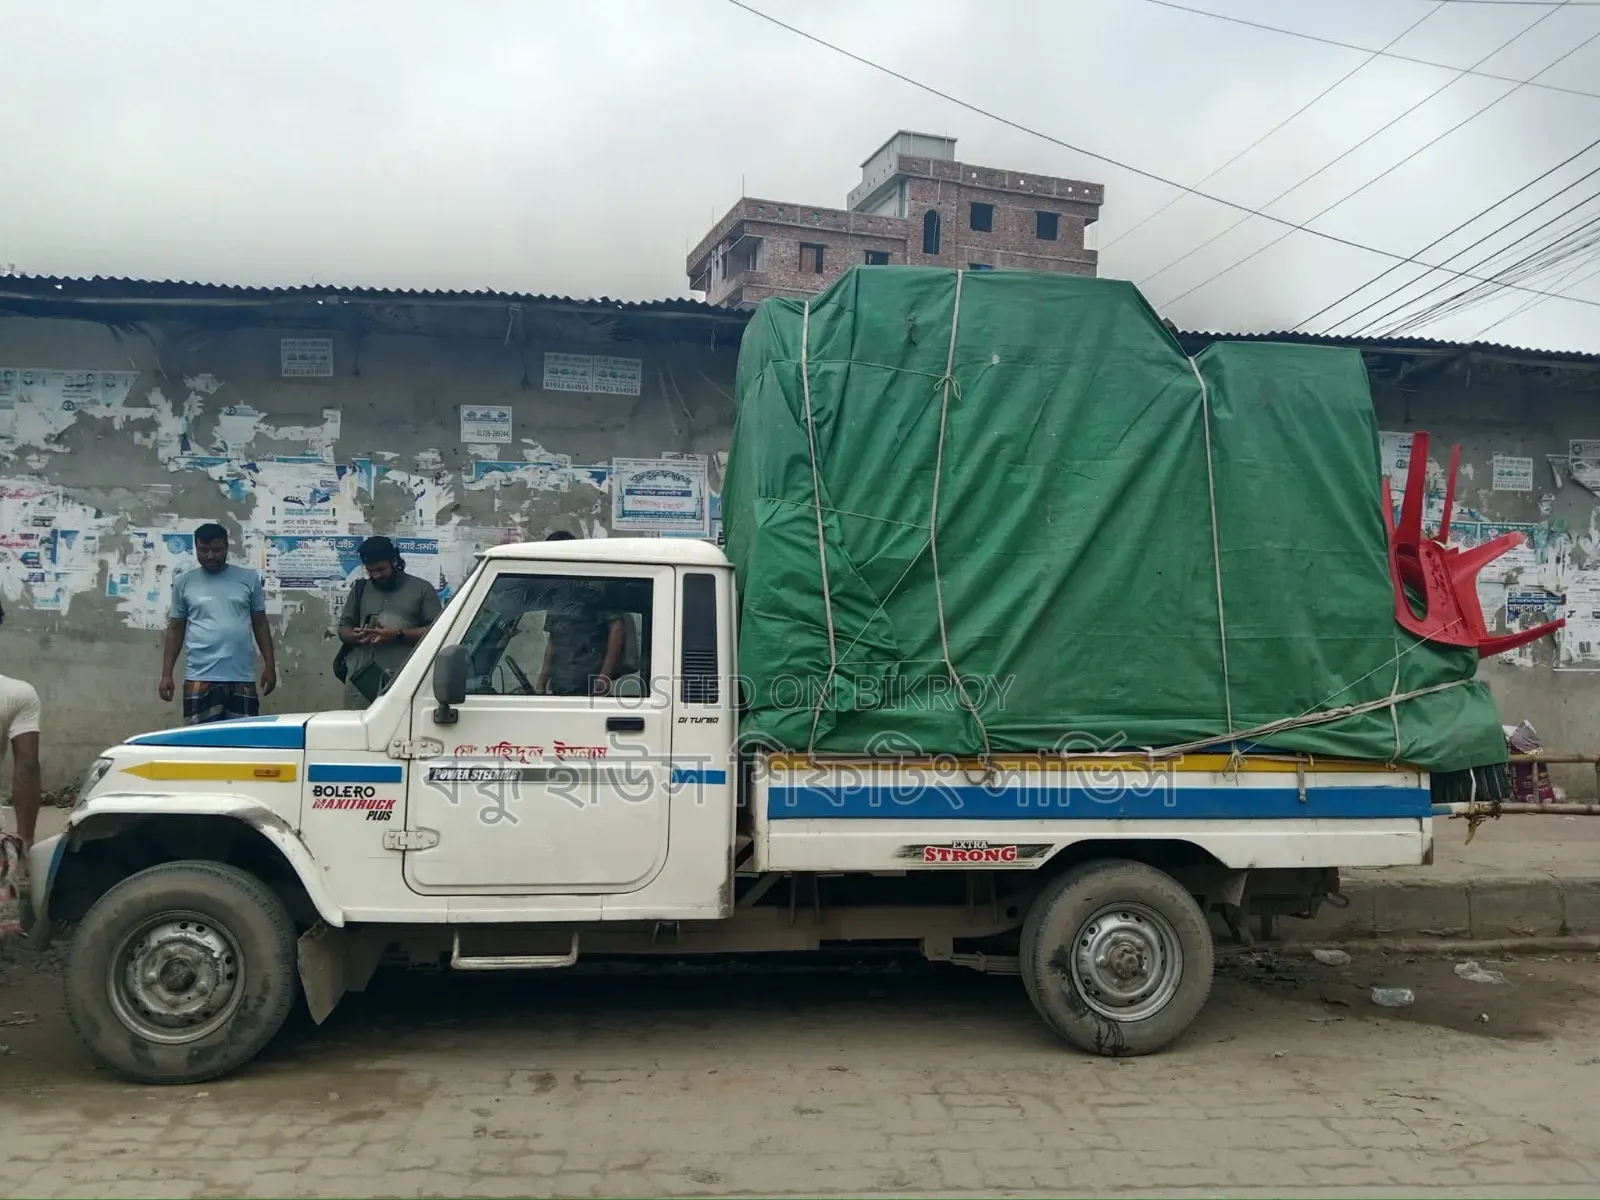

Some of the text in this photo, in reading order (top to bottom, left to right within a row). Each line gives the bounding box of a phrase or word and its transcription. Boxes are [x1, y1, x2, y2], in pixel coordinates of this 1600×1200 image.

[433, 769, 519, 781] POWER STEERING
[313, 786, 376, 799] BOLERO
[312, 799, 396, 810] MAXITRUCK
[366, 810, 393, 821] PLUS
[952, 840, 988, 849] EXTRA
[924, 845, 1017, 862] STRONG
